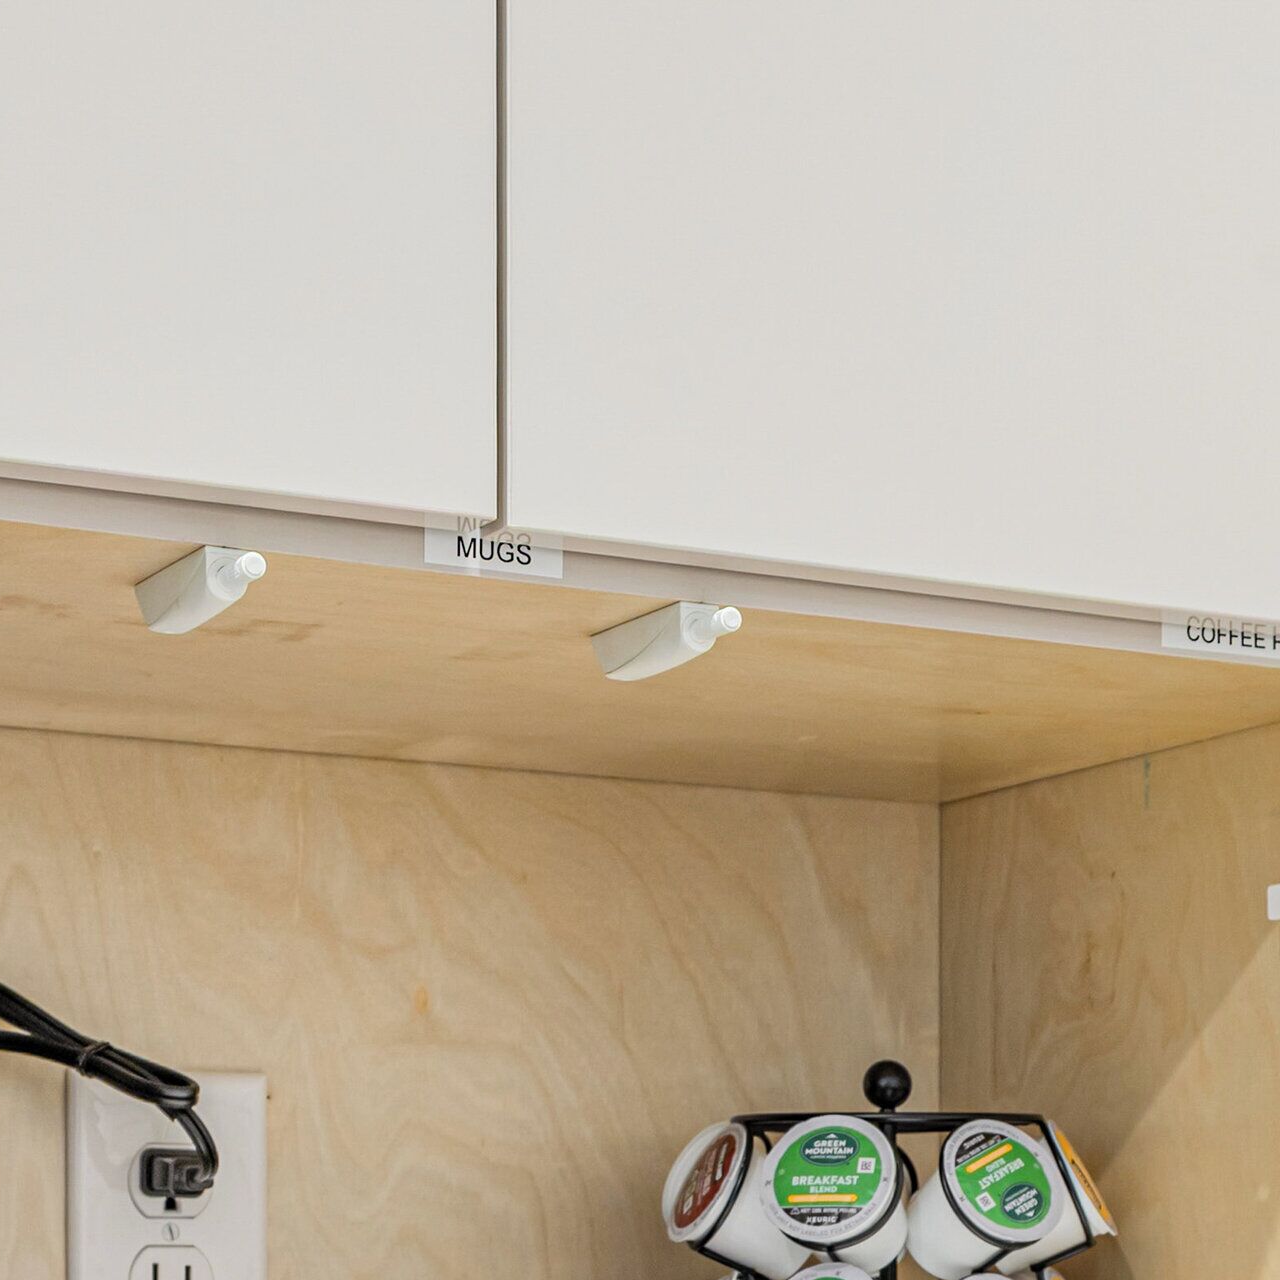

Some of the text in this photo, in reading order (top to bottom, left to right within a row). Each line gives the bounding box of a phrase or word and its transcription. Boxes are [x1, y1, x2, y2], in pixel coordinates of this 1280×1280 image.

[457, 535, 532, 565] MUGS
[1187, 624, 1266, 649] COFFEE
[804, 1146, 854, 1155] MOUNTAIN
[791, 1175, 860, 1186] BREAKFAST
[978, 1157, 1025, 1190] BREAKFAST
[806, 1216, 838, 1224] KEURIG
